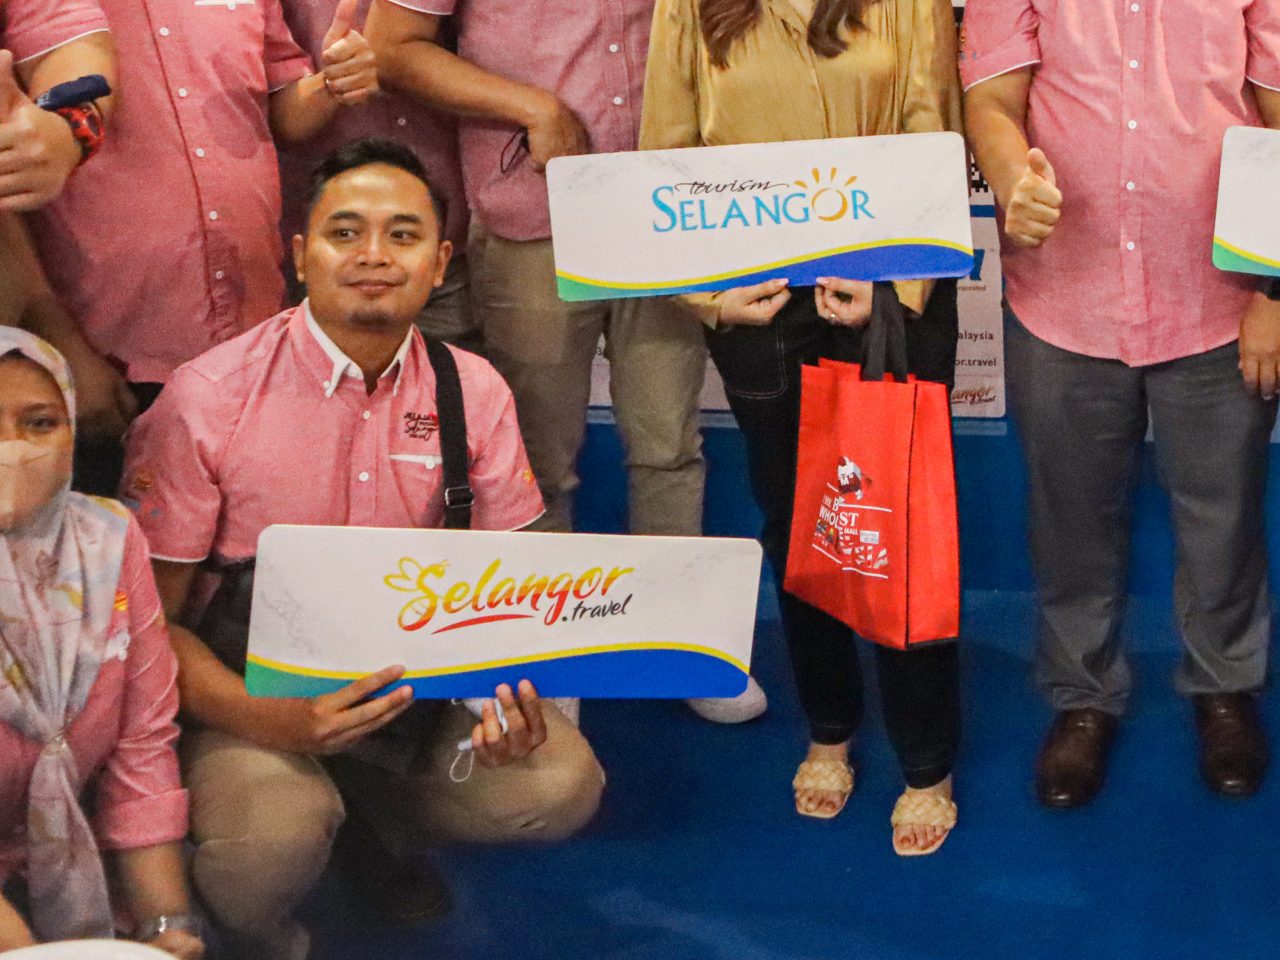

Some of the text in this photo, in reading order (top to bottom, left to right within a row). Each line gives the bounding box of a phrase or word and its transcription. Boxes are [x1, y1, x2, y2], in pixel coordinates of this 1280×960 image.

[675, 179, 790, 196] tourism
[652, 184, 877, 234] SELANGOR
[957, 331, 994, 342] alaysia
[955, 357, 997, 367] or.travel
[390, 558, 636, 632] Selangor
